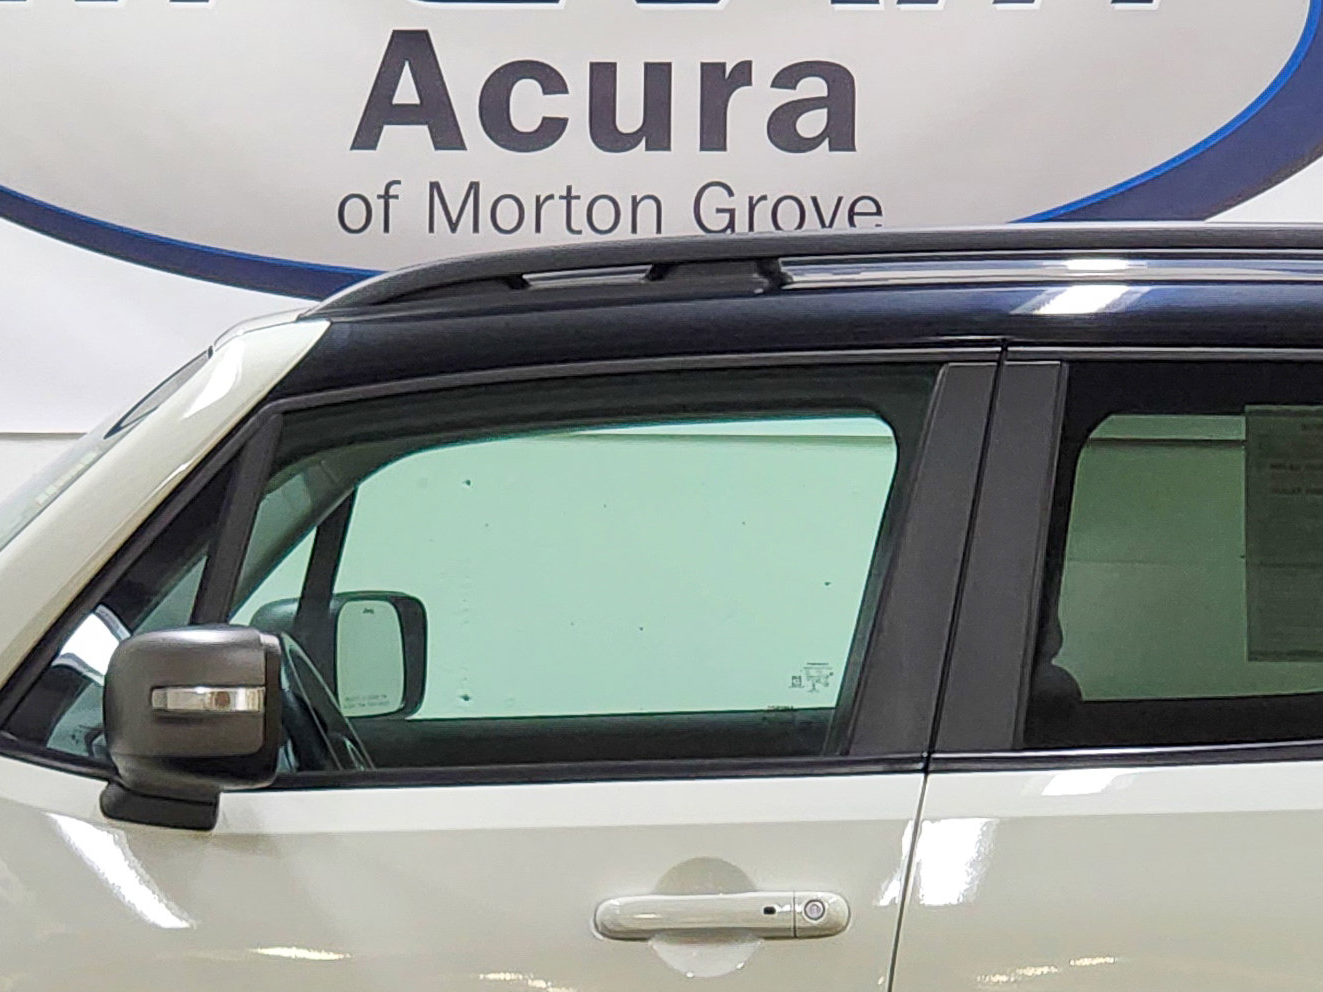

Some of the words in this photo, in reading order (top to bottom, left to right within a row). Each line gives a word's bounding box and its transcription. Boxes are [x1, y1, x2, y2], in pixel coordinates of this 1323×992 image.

[350, 29, 856, 153] Acura
[337, 180, 401, 235] of
[428, 180, 663, 235] Morton
[693, 181, 884, 235] Grove
